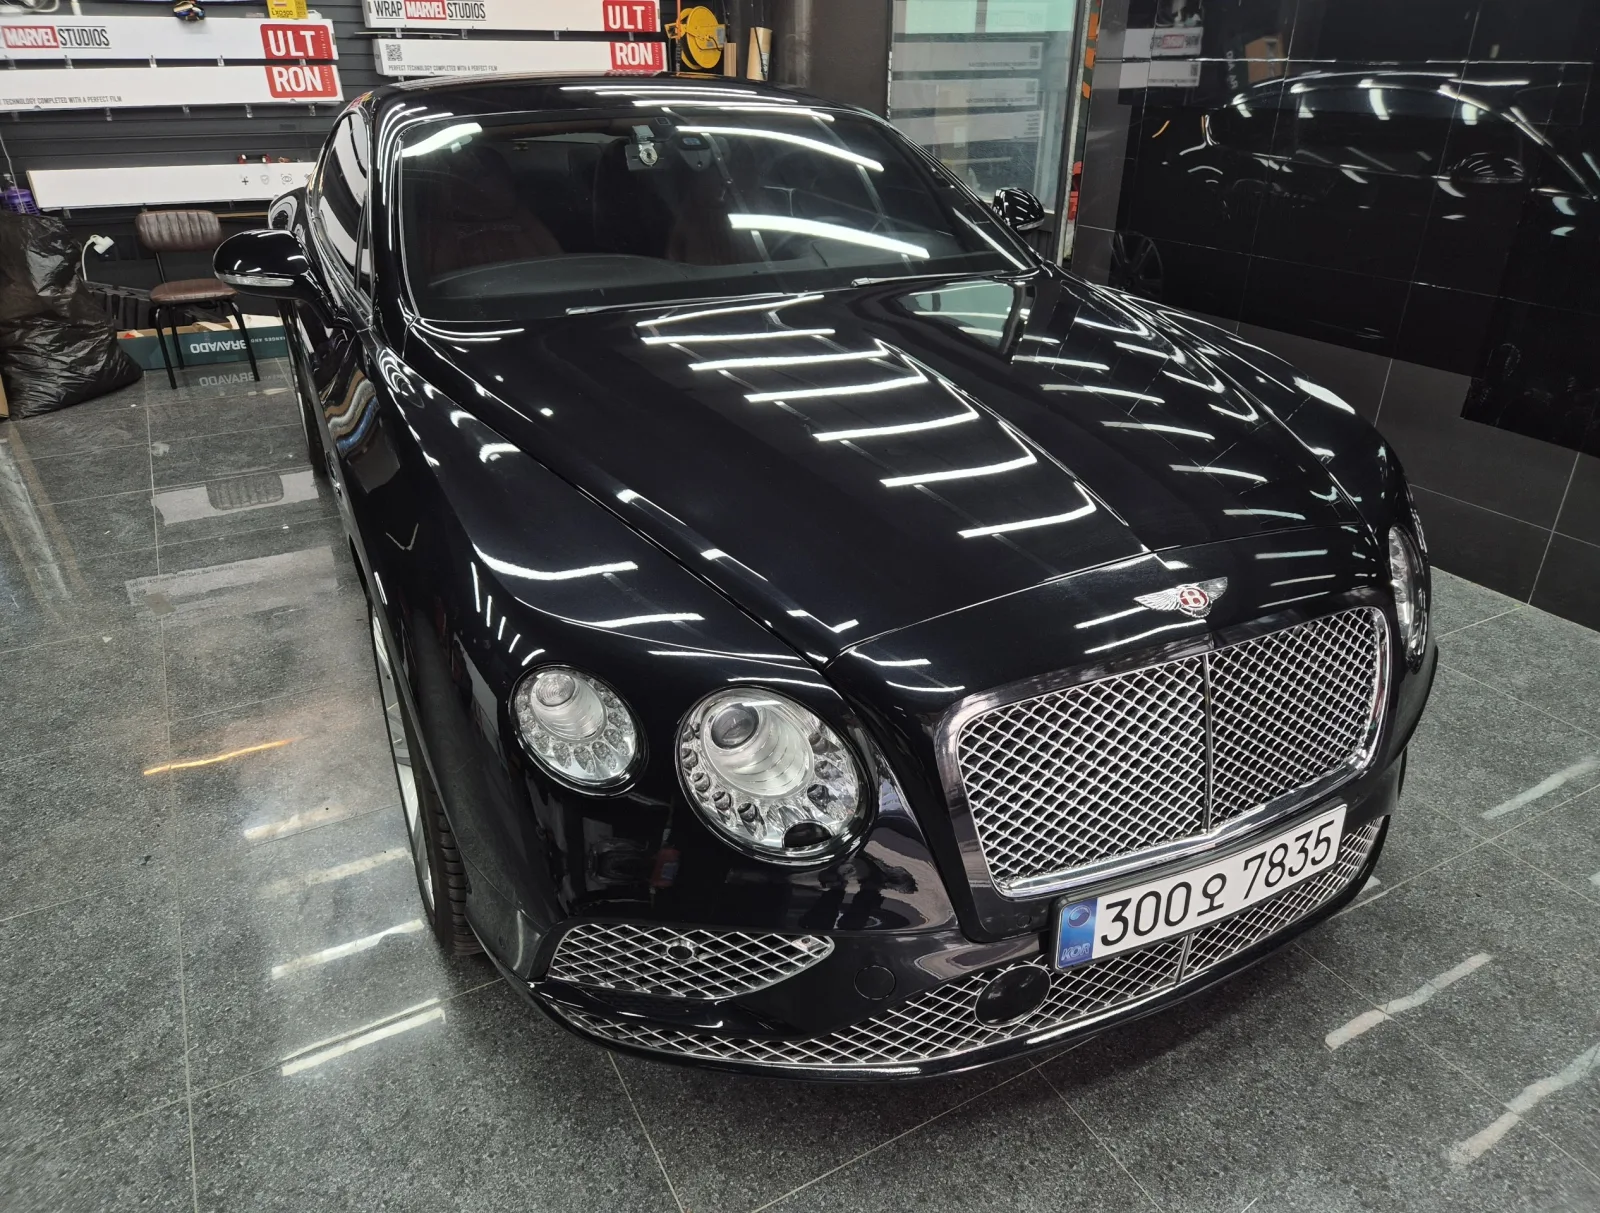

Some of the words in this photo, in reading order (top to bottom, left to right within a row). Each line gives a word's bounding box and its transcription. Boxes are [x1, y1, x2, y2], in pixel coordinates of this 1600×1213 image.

[375, 0, 403, 17] WRAP
[405, 1, 446, 18] MARVEL
[447, 2, 487, 19] STUDIOS
[607, 5, 646, 30] ULT
[2, 27, 58, 47] MARVEL
[58, 28, 110, 47] STUDIOS
[267, 30, 316, 57] ULT
[615, 42, 653, 66] RON
[272, 66, 324, 92] RON
[1101, 872, 1228, 947] 300오
[1243, 819, 1335, 900] 7835
[1060, 942, 1091, 961] KOR
